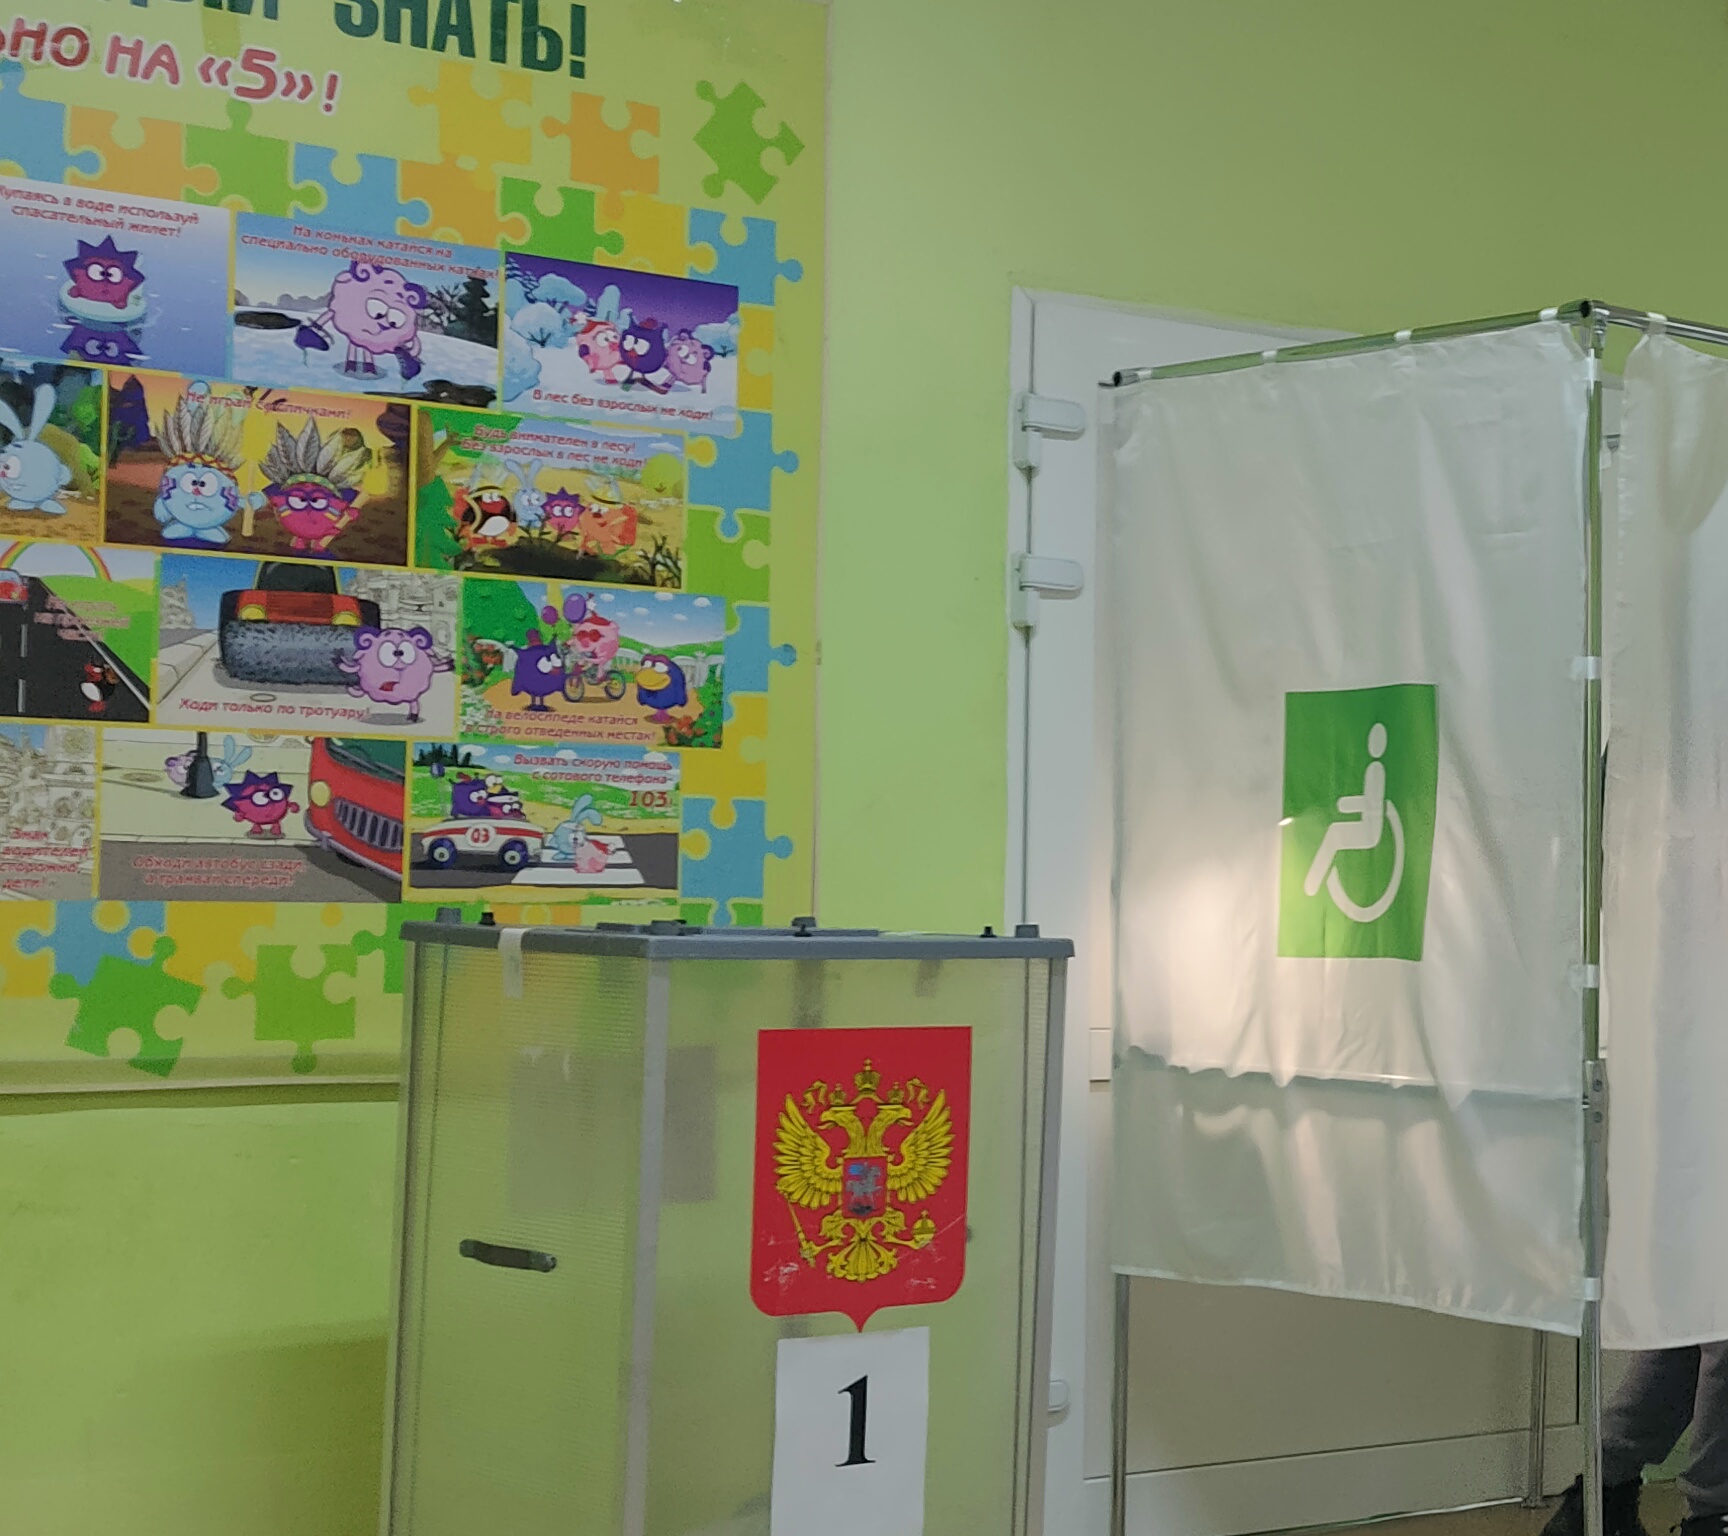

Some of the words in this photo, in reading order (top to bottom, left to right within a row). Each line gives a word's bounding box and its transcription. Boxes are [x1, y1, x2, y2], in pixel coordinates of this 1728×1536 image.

[105, 35, 180, 85] НА
[11, 205, 125, 230] спасательный
[128, 222, 182, 238] жилет!
[63, 196, 72, 207] в
[76, 198, 115, 213] воде
[118, 204, 200, 225] используй
[240, 235, 328, 256] специально
[332, 246, 445, 272] оборудованных
[293, 225, 311, 238] На
[315, 230, 373, 247] коньках
[377, 238, 433, 256] катайся
[436, 248, 453, 259] на
[533, 389, 544, 401] В
[546, 392, 568, 404] лес
[571, 393, 594, 406] без
[598, 399, 658, 414] взрослых
[661, 405, 676, 417] не
[474, 424, 508, 440] Будь
[510, 430, 589, 449] внимателен
[591, 438, 599, 449] в
[602, 441, 637, 455] лесу!
[490, 443, 554, 458] взрослых
[556, 450, 564, 460] в
[566, 451, 590, 463] лес
[592, 454, 609, 464] не
[179, 698, 218, 713] Ходи
[222, 700, 273, 714] только
[276, 703, 296, 715] по
[299, 705, 371, 721] тротуару!
[505, 710, 585, 725] велосипеде
[588, 713, 638, 726] катайся
[476, 724, 521, 736] строго
[513, 753, 569, 767] Вызвать
[572, 757, 621, 770] скорую
[624, 760, 673, 772] помощь
[531, 771, 540, 781] с
[542, 771, 602, 783] сотового
[629, 790, 668, 808] 103
[470, 827, 490, 844] 03
[834, 1374, 877, 1467] 1
